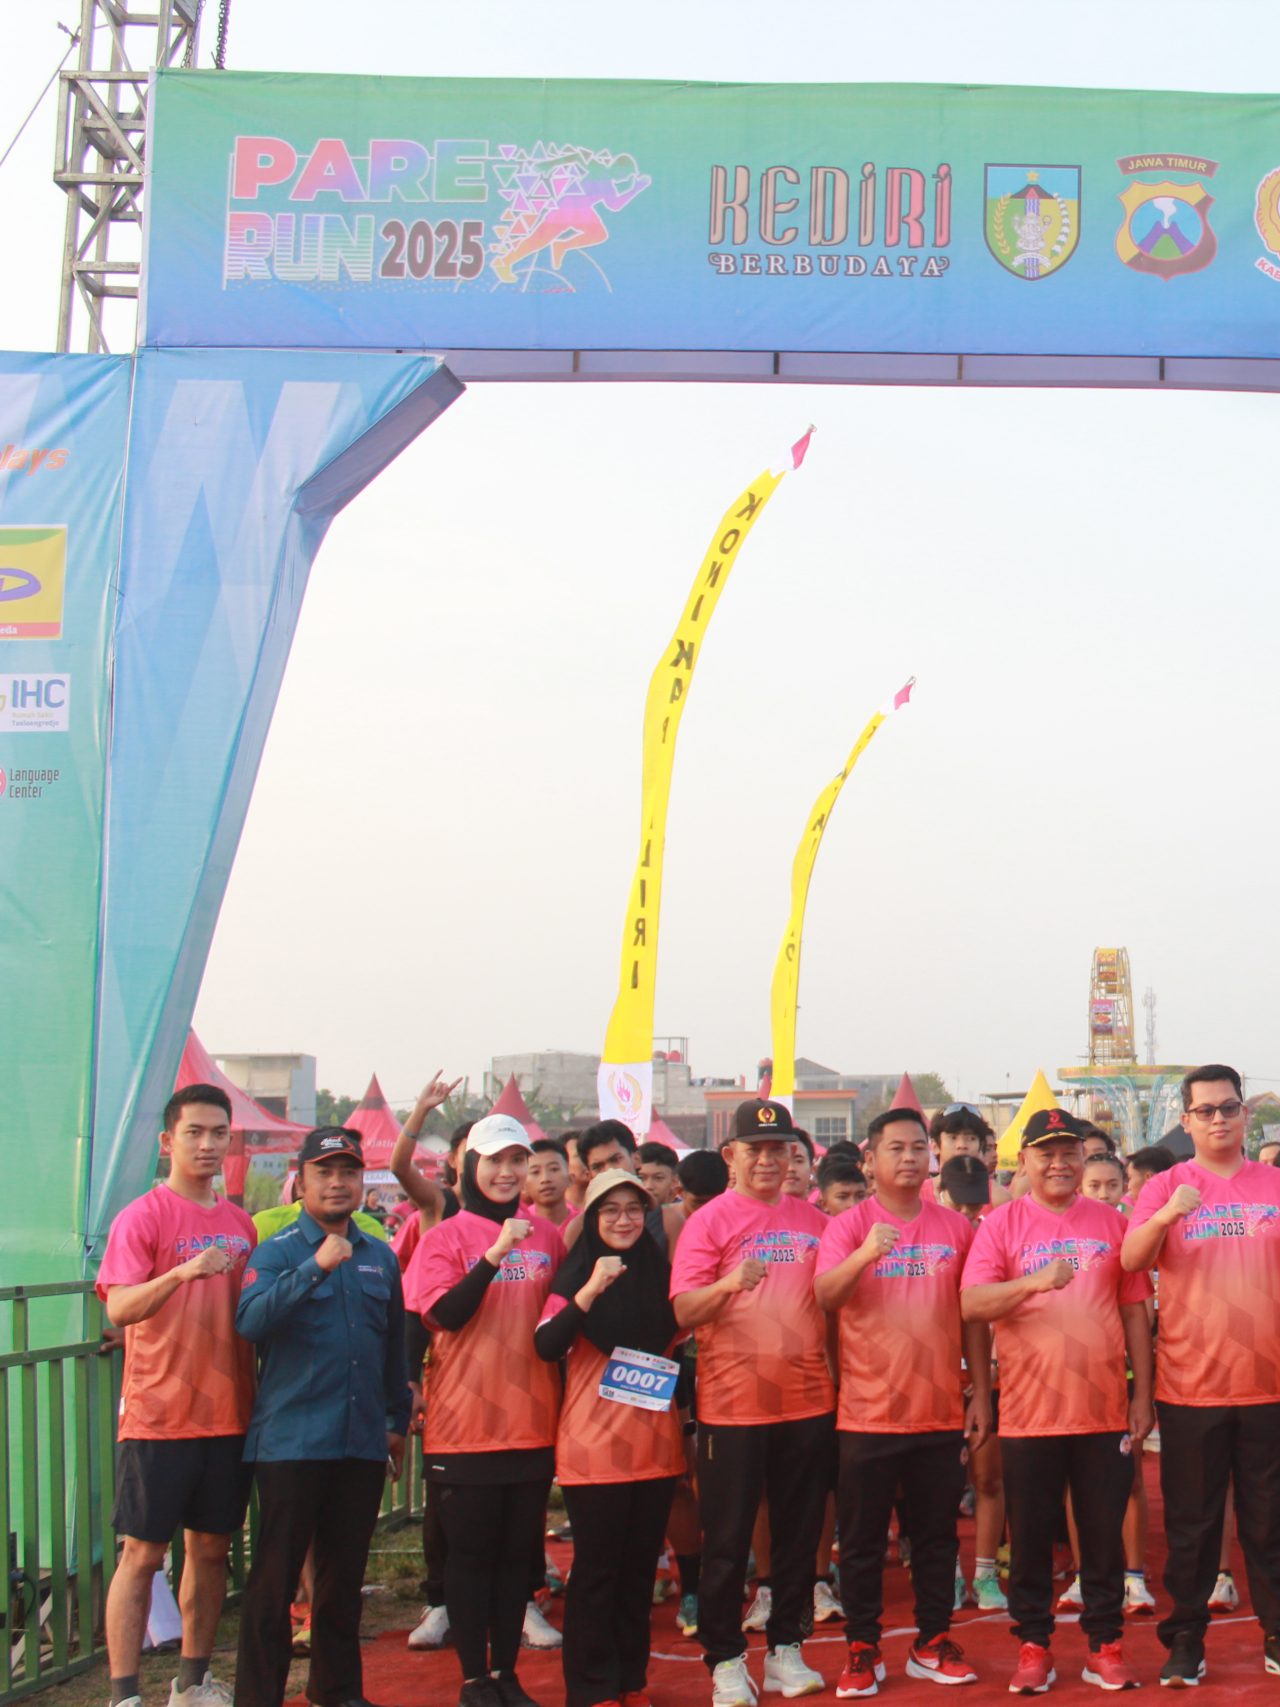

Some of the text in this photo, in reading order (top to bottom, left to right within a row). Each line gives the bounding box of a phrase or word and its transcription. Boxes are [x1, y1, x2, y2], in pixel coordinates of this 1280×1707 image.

[232, 136, 490, 202] PARE
[1127, 157, 1208, 173] JAWA TIMUR
[227, 213, 486, 282] RUN 2025
[708, 253, 951, 278] BERBUDAYA
[12, 678, 66, 709] IHC
[10, 767, 61, 785] Language
[9, 784, 43, 799] Center
[1184, 1221, 1245, 1241] RUN 2025
[773, 1248, 796, 1263] 2025
[1020, 1239, 1078, 1258] PARE
[874, 1261, 907, 1278] RUN
[611, 1365, 670, 1392] 0007
